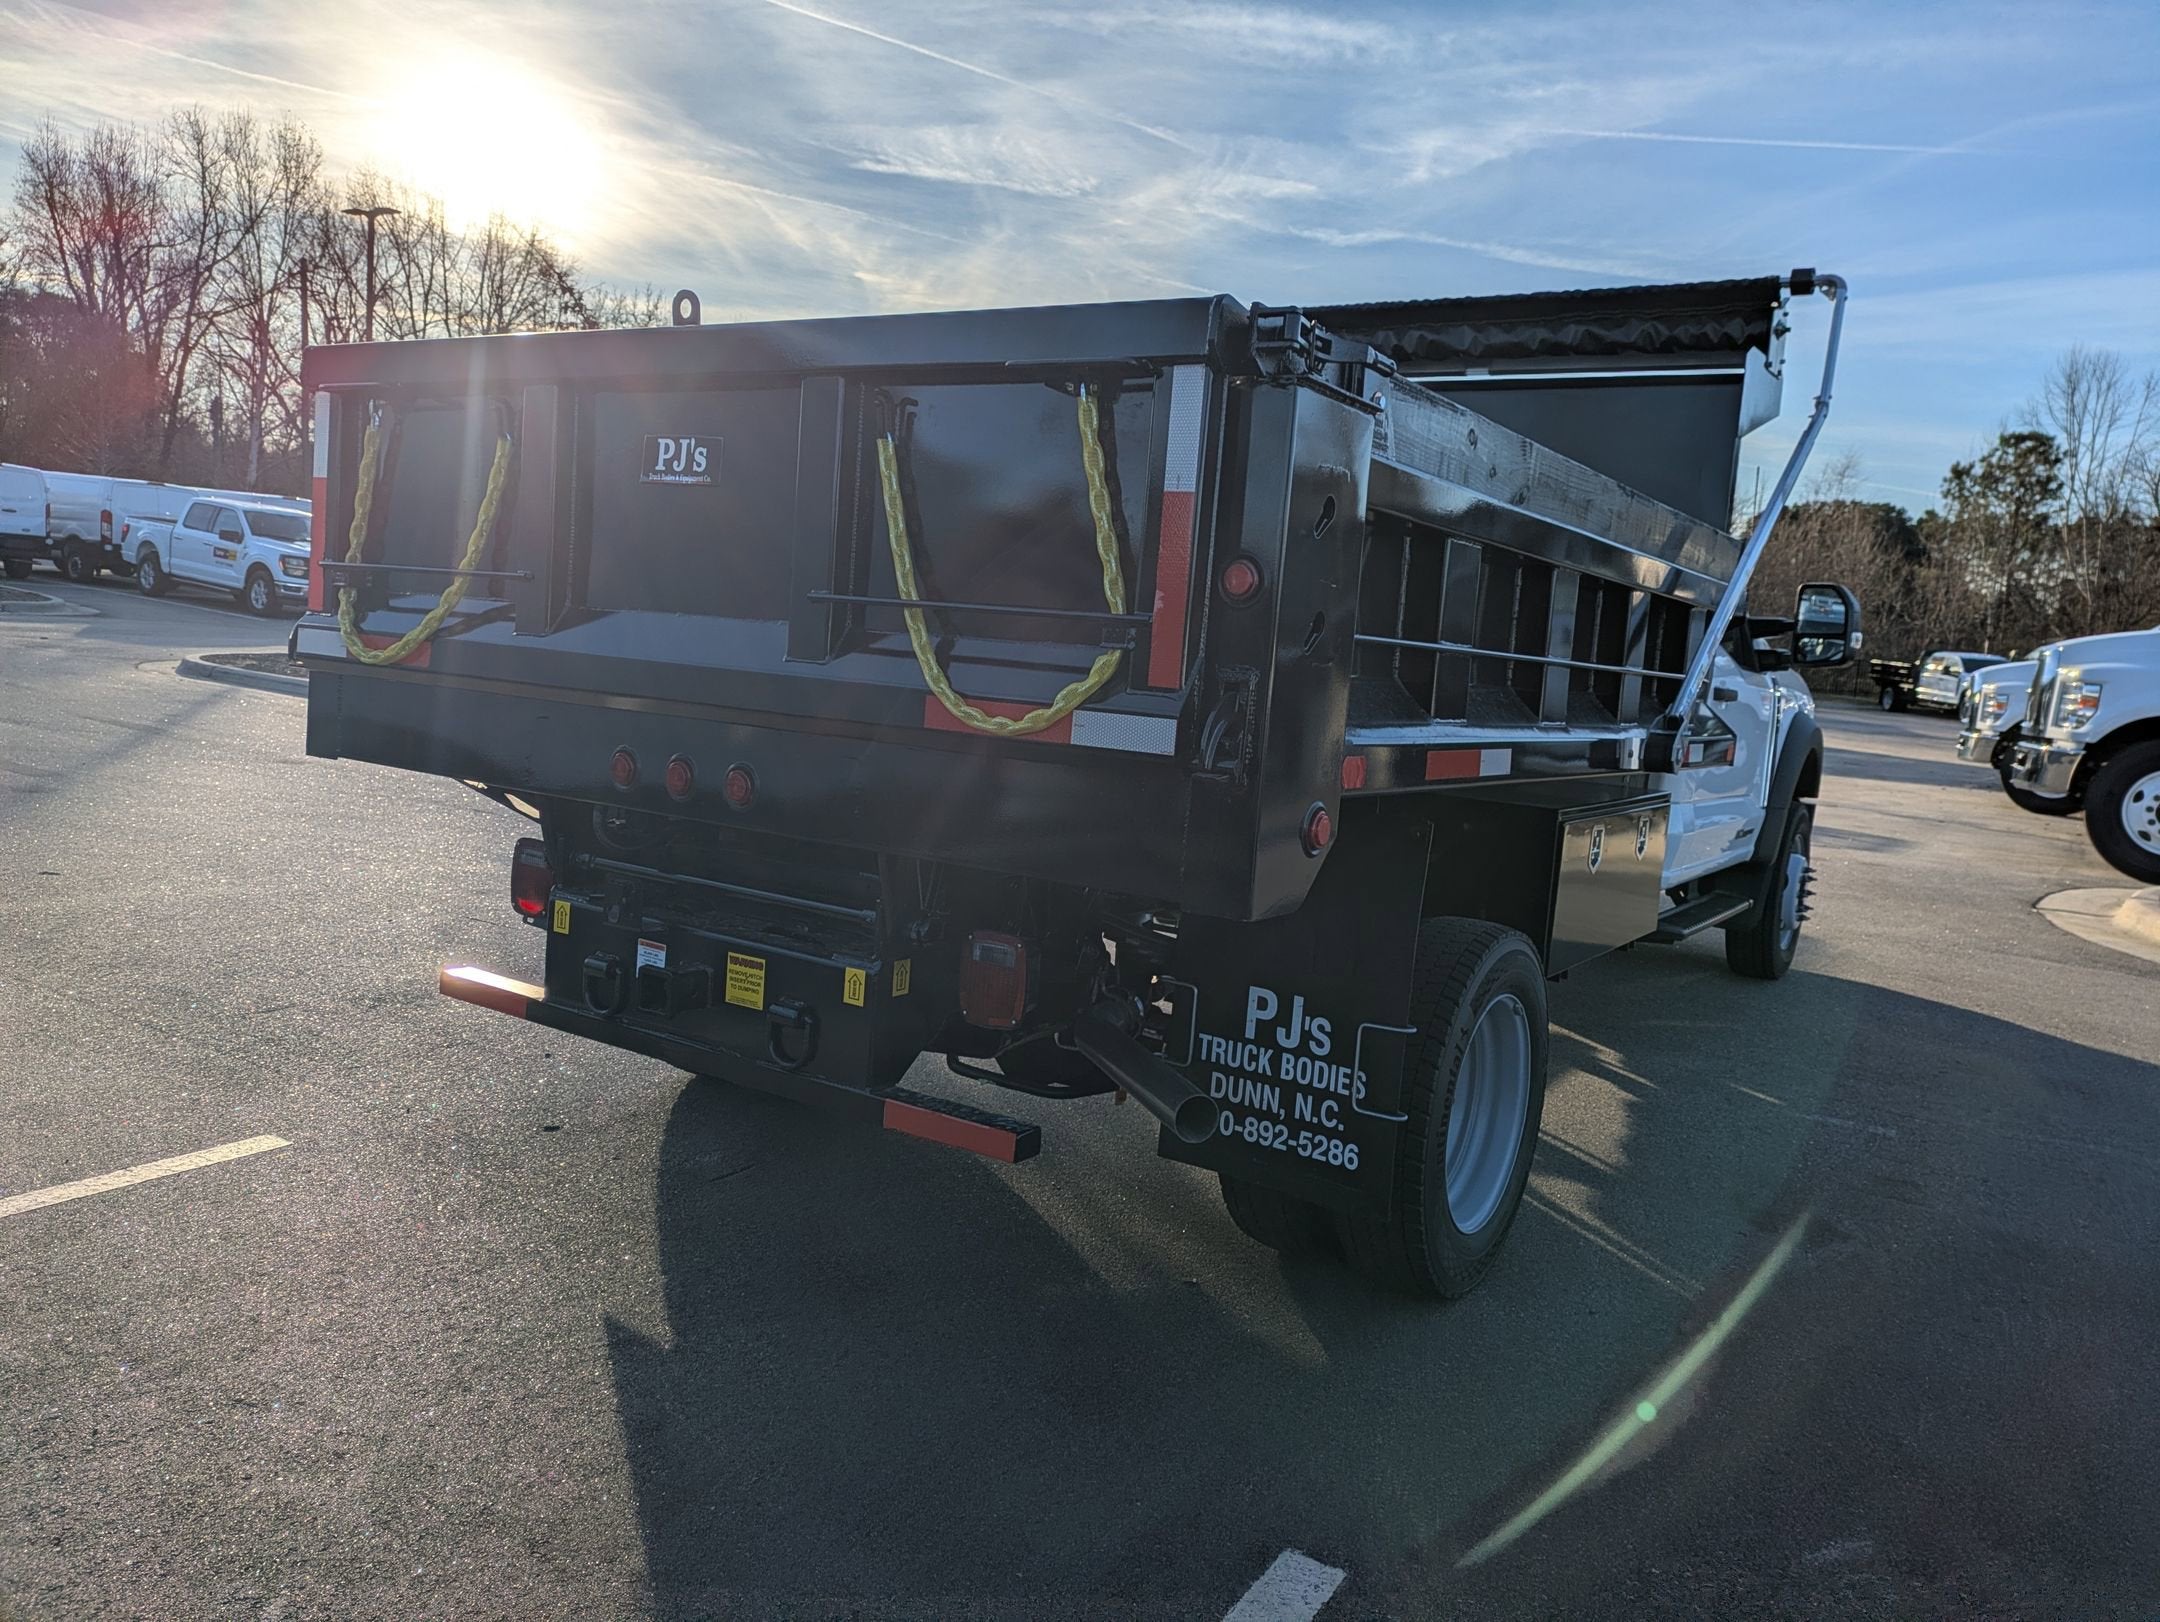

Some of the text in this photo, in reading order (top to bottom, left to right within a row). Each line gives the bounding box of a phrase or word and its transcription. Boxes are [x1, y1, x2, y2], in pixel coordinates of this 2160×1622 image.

[655, 437, 707, 472] PJ's
[1199, 1032, 1367, 1100] TRUCK BODIES
[1210, 1071, 1345, 1131] DUNN, N.C.
[1219, 1110, 1359, 1171] 0-892-5286
